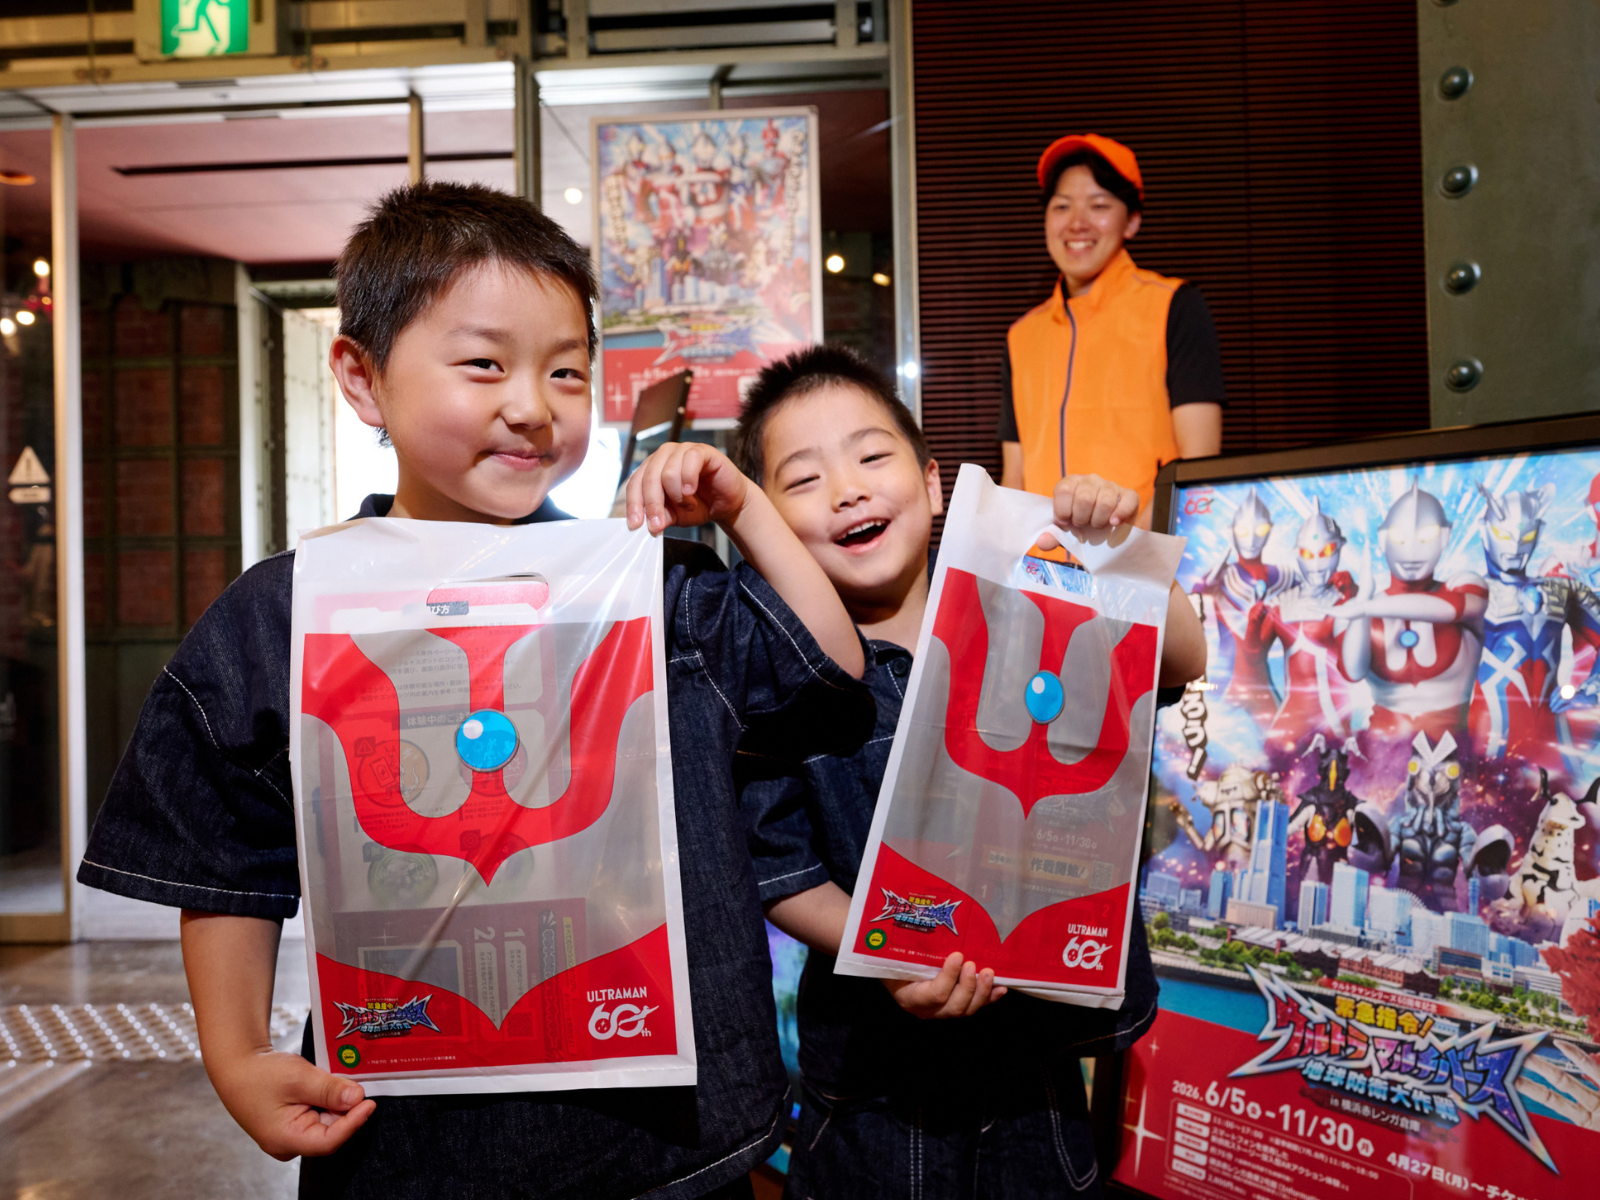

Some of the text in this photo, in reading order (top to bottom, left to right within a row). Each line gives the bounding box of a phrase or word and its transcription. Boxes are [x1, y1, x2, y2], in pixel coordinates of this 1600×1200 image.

[1067, 923, 1109, 938] ULTRAMAN
[586, 986, 648, 1003] ULTRAMAN
[1335, 995, 1435, 1038] 緊急指令!
[1262, 991, 1529, 1141] ウルトラマルチバース
[1302, 1059, 1460, 1124] 地球防衛大作戦
[1340, 1098, 1422, 1133] 横浜赤レンガ倉庫
